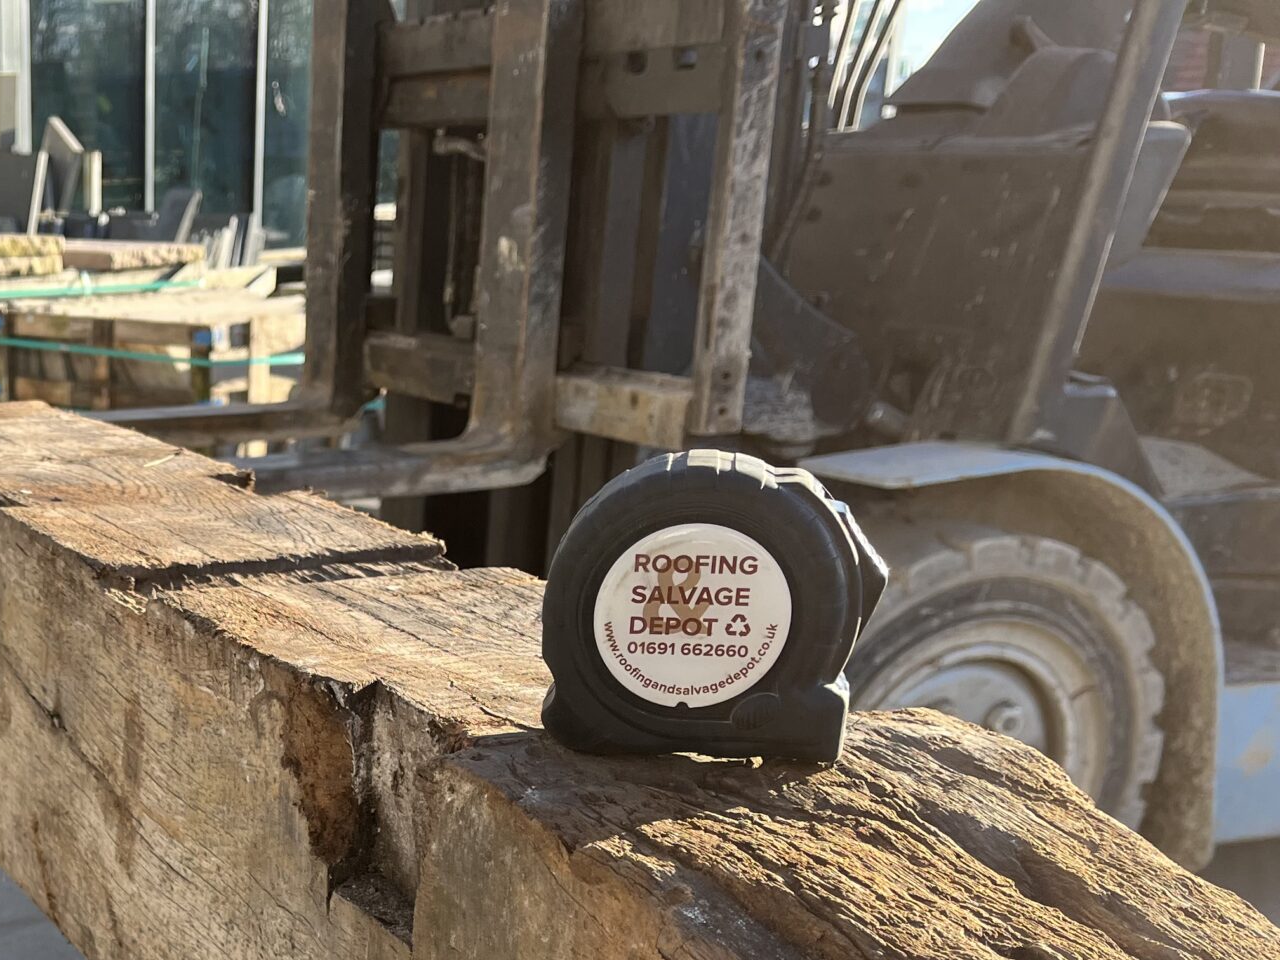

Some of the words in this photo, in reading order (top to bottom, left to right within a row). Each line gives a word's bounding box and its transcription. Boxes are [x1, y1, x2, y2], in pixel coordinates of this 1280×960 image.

[634, 554, 759, 575] ROOFING
[631, 585, 751, 607] SALVAGE
[629, 616, 719, 637] DEPOT
[604, 621, 778, 695] www.roofingandsalvagedepot.co.uk
[627, 641, 675, 656] 01691
[680, 643, 749, 658] 662660
